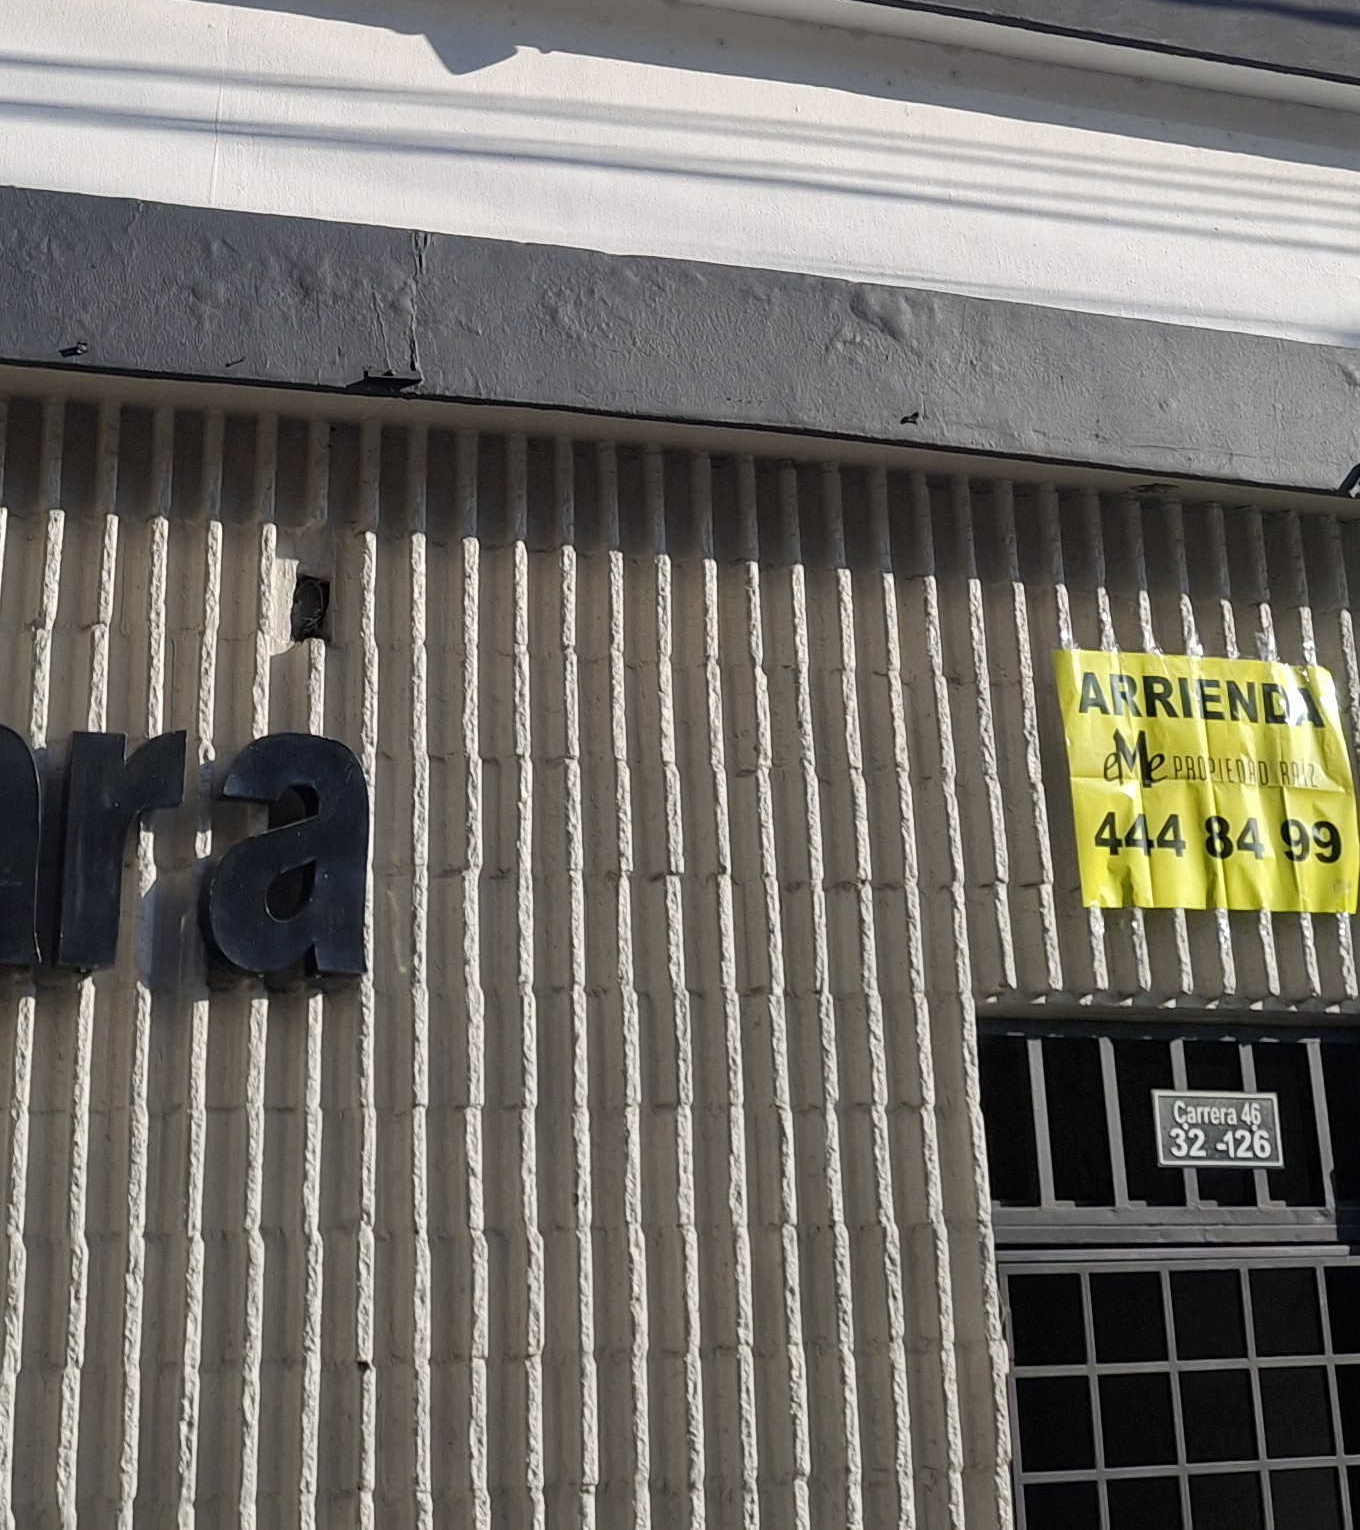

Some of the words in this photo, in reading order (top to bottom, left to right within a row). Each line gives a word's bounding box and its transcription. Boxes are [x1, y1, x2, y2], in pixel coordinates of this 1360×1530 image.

[1078, 672, 1325, 728] ARRIENDA
[1173, 755, 1268, 786] PROPIEDAD
[1095, 812, 1187, 858] 444
[1205, 816, 1266, 860] 84
[1281, 819, 1343, 864] 99
[1173, 1100, 1237, 1125] Carrera
[1241, 1102, 1262, 1125] 46
[1169, 1127, 1207, 1157] 32
